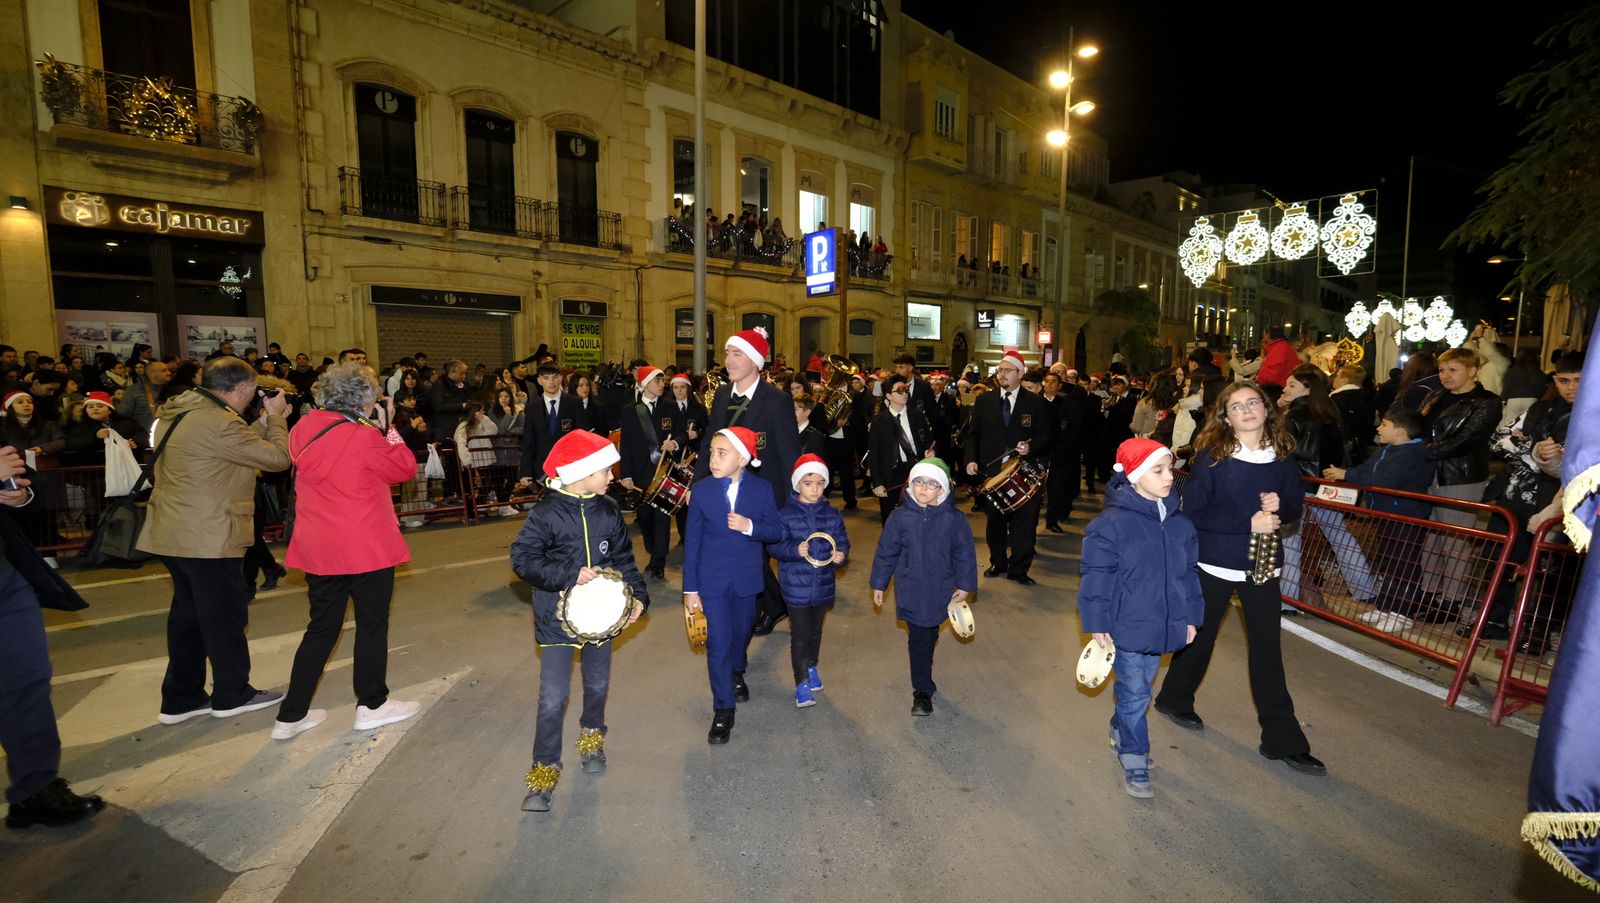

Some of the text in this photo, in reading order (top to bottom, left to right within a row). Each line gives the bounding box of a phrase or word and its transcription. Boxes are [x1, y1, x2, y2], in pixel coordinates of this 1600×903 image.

[119, 203, 251, 235] cajamar
[812, 235, 828, 274] P
[563, 324, 600, 334] SE VENDE
[564, 338, 600, 349] O ALQUILA
